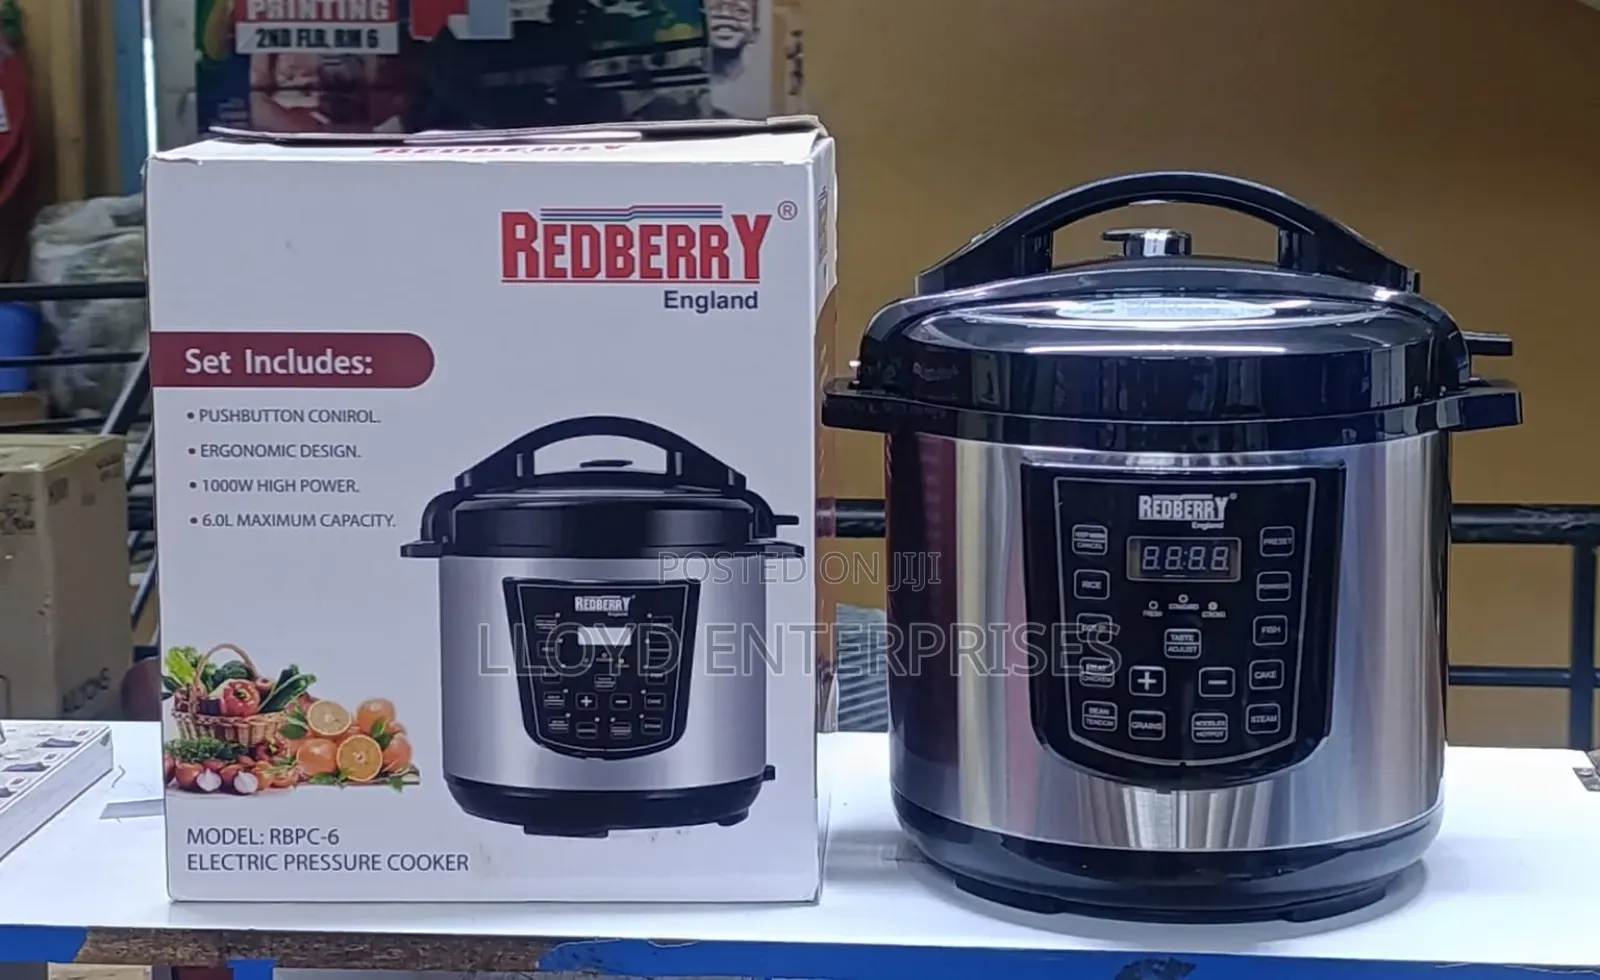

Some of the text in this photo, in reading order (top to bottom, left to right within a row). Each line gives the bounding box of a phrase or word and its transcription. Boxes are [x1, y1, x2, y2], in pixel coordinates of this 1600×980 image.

[247, 0, 391, 20] PRINTING
[255, 28, 291, 48] 2ND
[366, 28, 379, 48] 6
[501, 209, 772, 281] REDBERRY
[664, 290, 759, 313] England
[185, 348, 373, 374] Set Includes:
[199, 409, 305, 423] PUSHBUTTON
[200, 444, 362, 458] ERGONOMIC DESIGN.
[202, 479, 361, 493] 1000W HIGH POWER.
[1138, 494, 1228, 521] REDBERRY
[202, 514, 396, 527] 6.0L MAXIMUM CAPACITY.
[574, 595, 632, 612] REDBERRY
[1254, 670, 1277, 680] CAKE
[1250, 714, 1278, 724] STEAM
[187, 828, 340, 845] MODEL: RBPC-6
[187, 854, 470, 871] ELECTRIC PRESSURE COOKER
